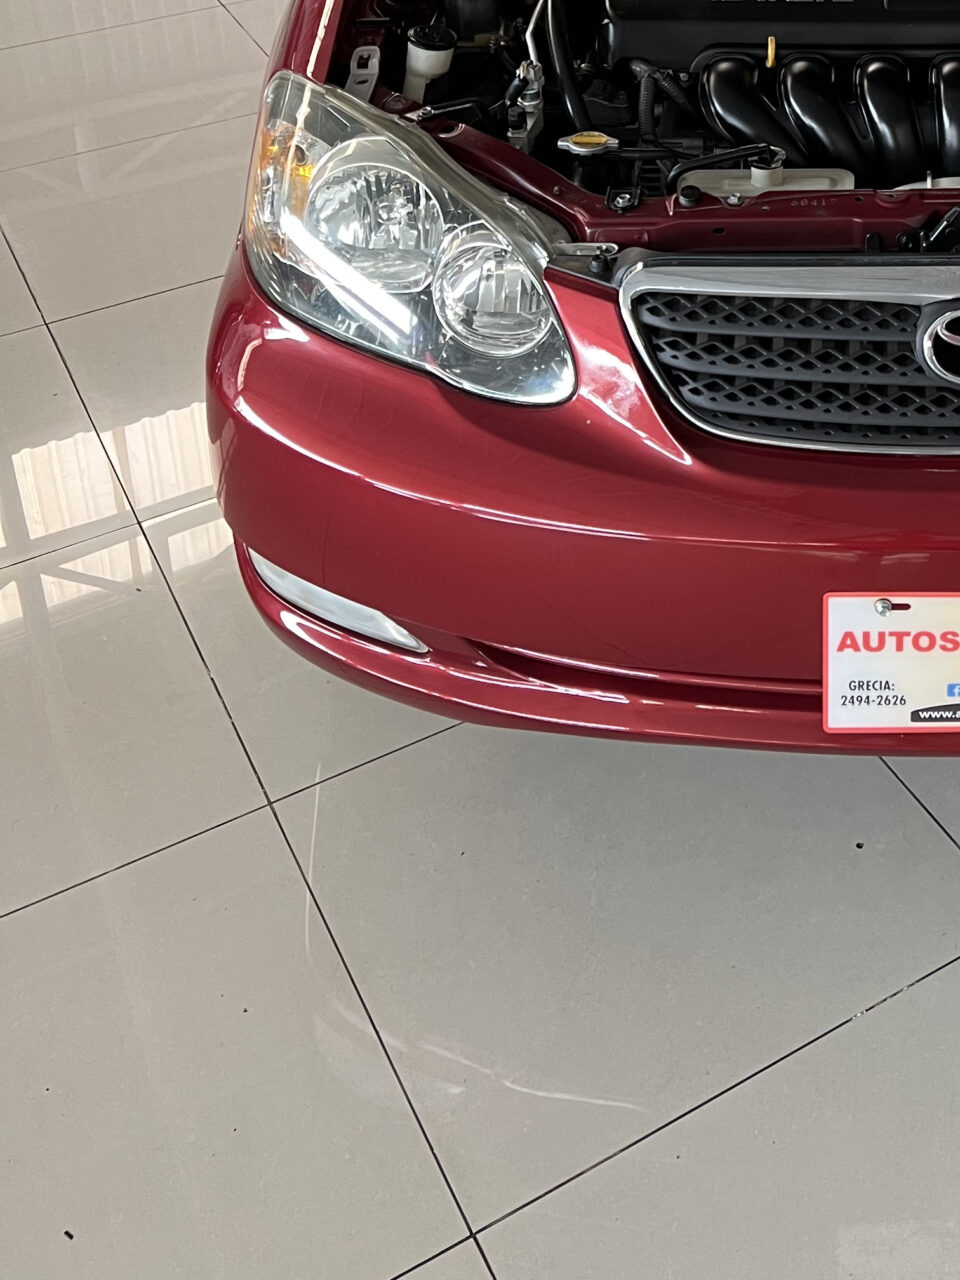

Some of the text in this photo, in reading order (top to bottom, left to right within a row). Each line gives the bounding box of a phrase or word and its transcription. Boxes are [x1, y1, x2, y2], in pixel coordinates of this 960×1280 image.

[836, 630, 960, 653] AUTOS
[848, 680, 895, 692] GRECIA:
[840, 694, 907, 707] 2494-2626
